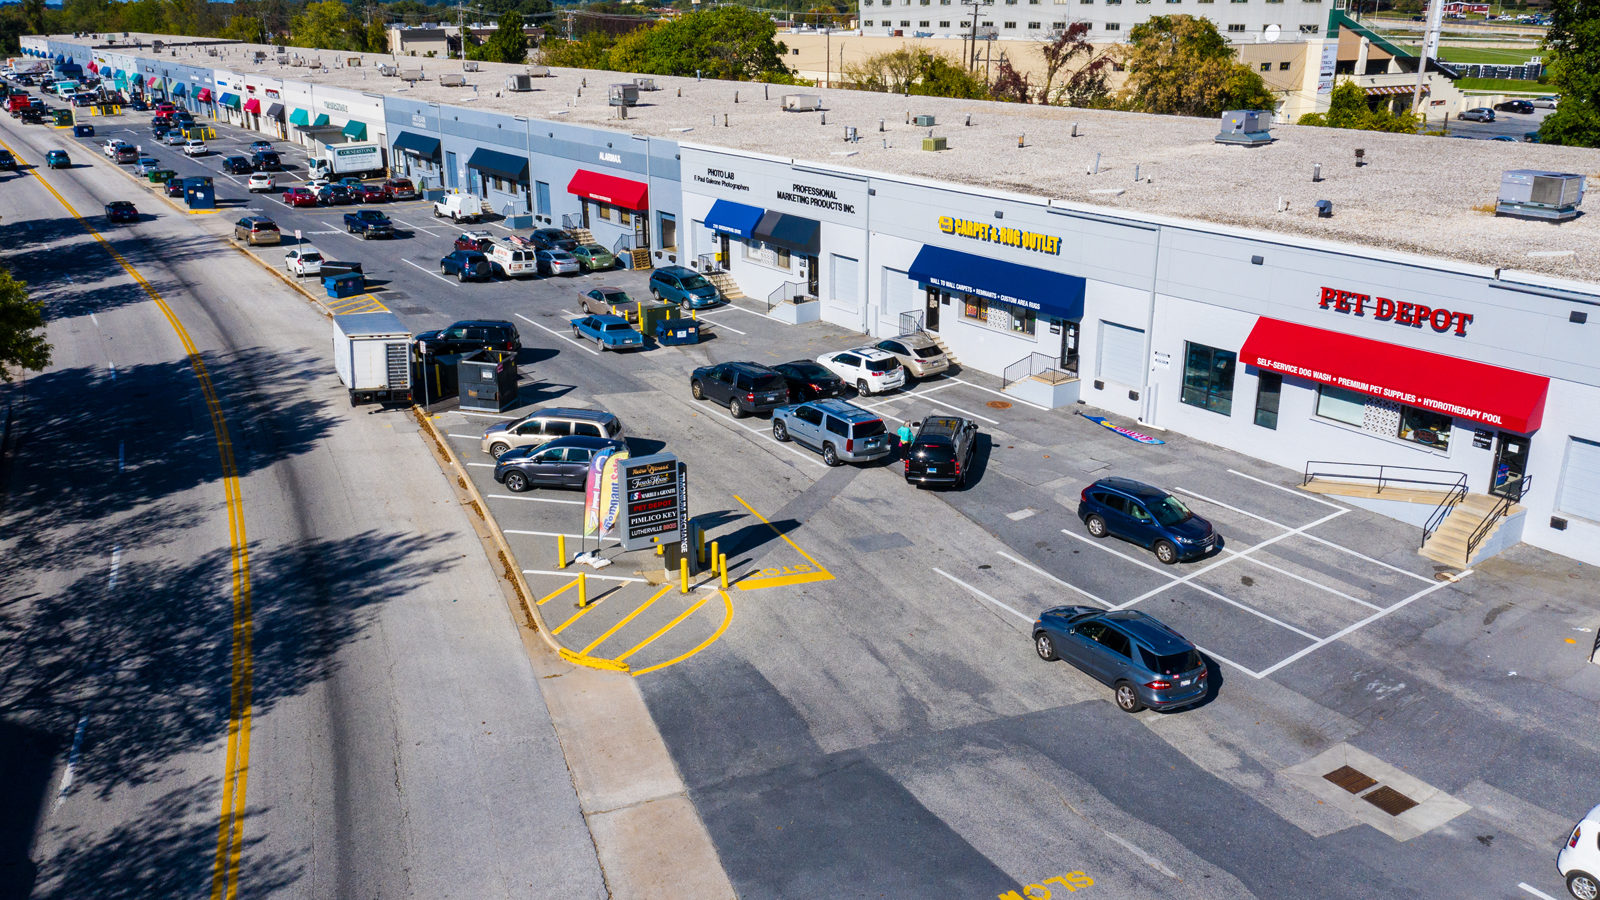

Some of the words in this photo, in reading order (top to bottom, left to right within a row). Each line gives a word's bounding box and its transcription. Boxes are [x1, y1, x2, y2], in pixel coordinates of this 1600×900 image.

[698, 175, 706, 183] Paul
[721, 180, 750, 192] Photographers
[707, 168, 724, 179] PHOTO
[724, 171, 735, 180] LAB
[792, 183, 838, 200] PROFESSIONAL
[776, 190, 810, 206] MARKETING
[810, 198, 843, 212] PRODUCTS
[843, 204, 856, 214] INC.
[954, 218, 991, 241] CARPET
[990, 226, 1000, 242] &
[1000, 226, 1022, 247] RUG
[1022, 231, 1061, 255] OUTLET
[946, 280, 956, 290] WALL
[956, 283, 972, 293] CARPETS
[976, 288, 997, 299] REMNANTS
[1000, 294, 1017, 305] CUSTOM
[1016, 298, 1028, 308] AREA
[1028, 302, 1040, 310] RUGS
[1318, 286, 1370, 316] PET
[1373, 296, 1473, 336] DEPOT
[1256, 357, 1298, 374] SELF-SERVICE
[1298, 366, 1312, 378] DOG
[1312, 370, 1332, 382] WASH
[1337, 376, 1369, 392] PREMIUM
[1369, 382, 1383, 395] PET
[1382, 386, 1416, 404] SUPPLIES
[1422, 397, 1481, 420] HYDROTHERAPY
[1481, 410, 1503, 425] POOL
[633, 504, 647, 512] PET
[648, 500, 672, 510] DEPOT
[630, 512, 662, 525] PIMLICO
[662, 510, 677, 519] KEY
[631, 525, 662, 536] LUTHERVILLE
[680, 513, 688, 554] EXCHANGE
